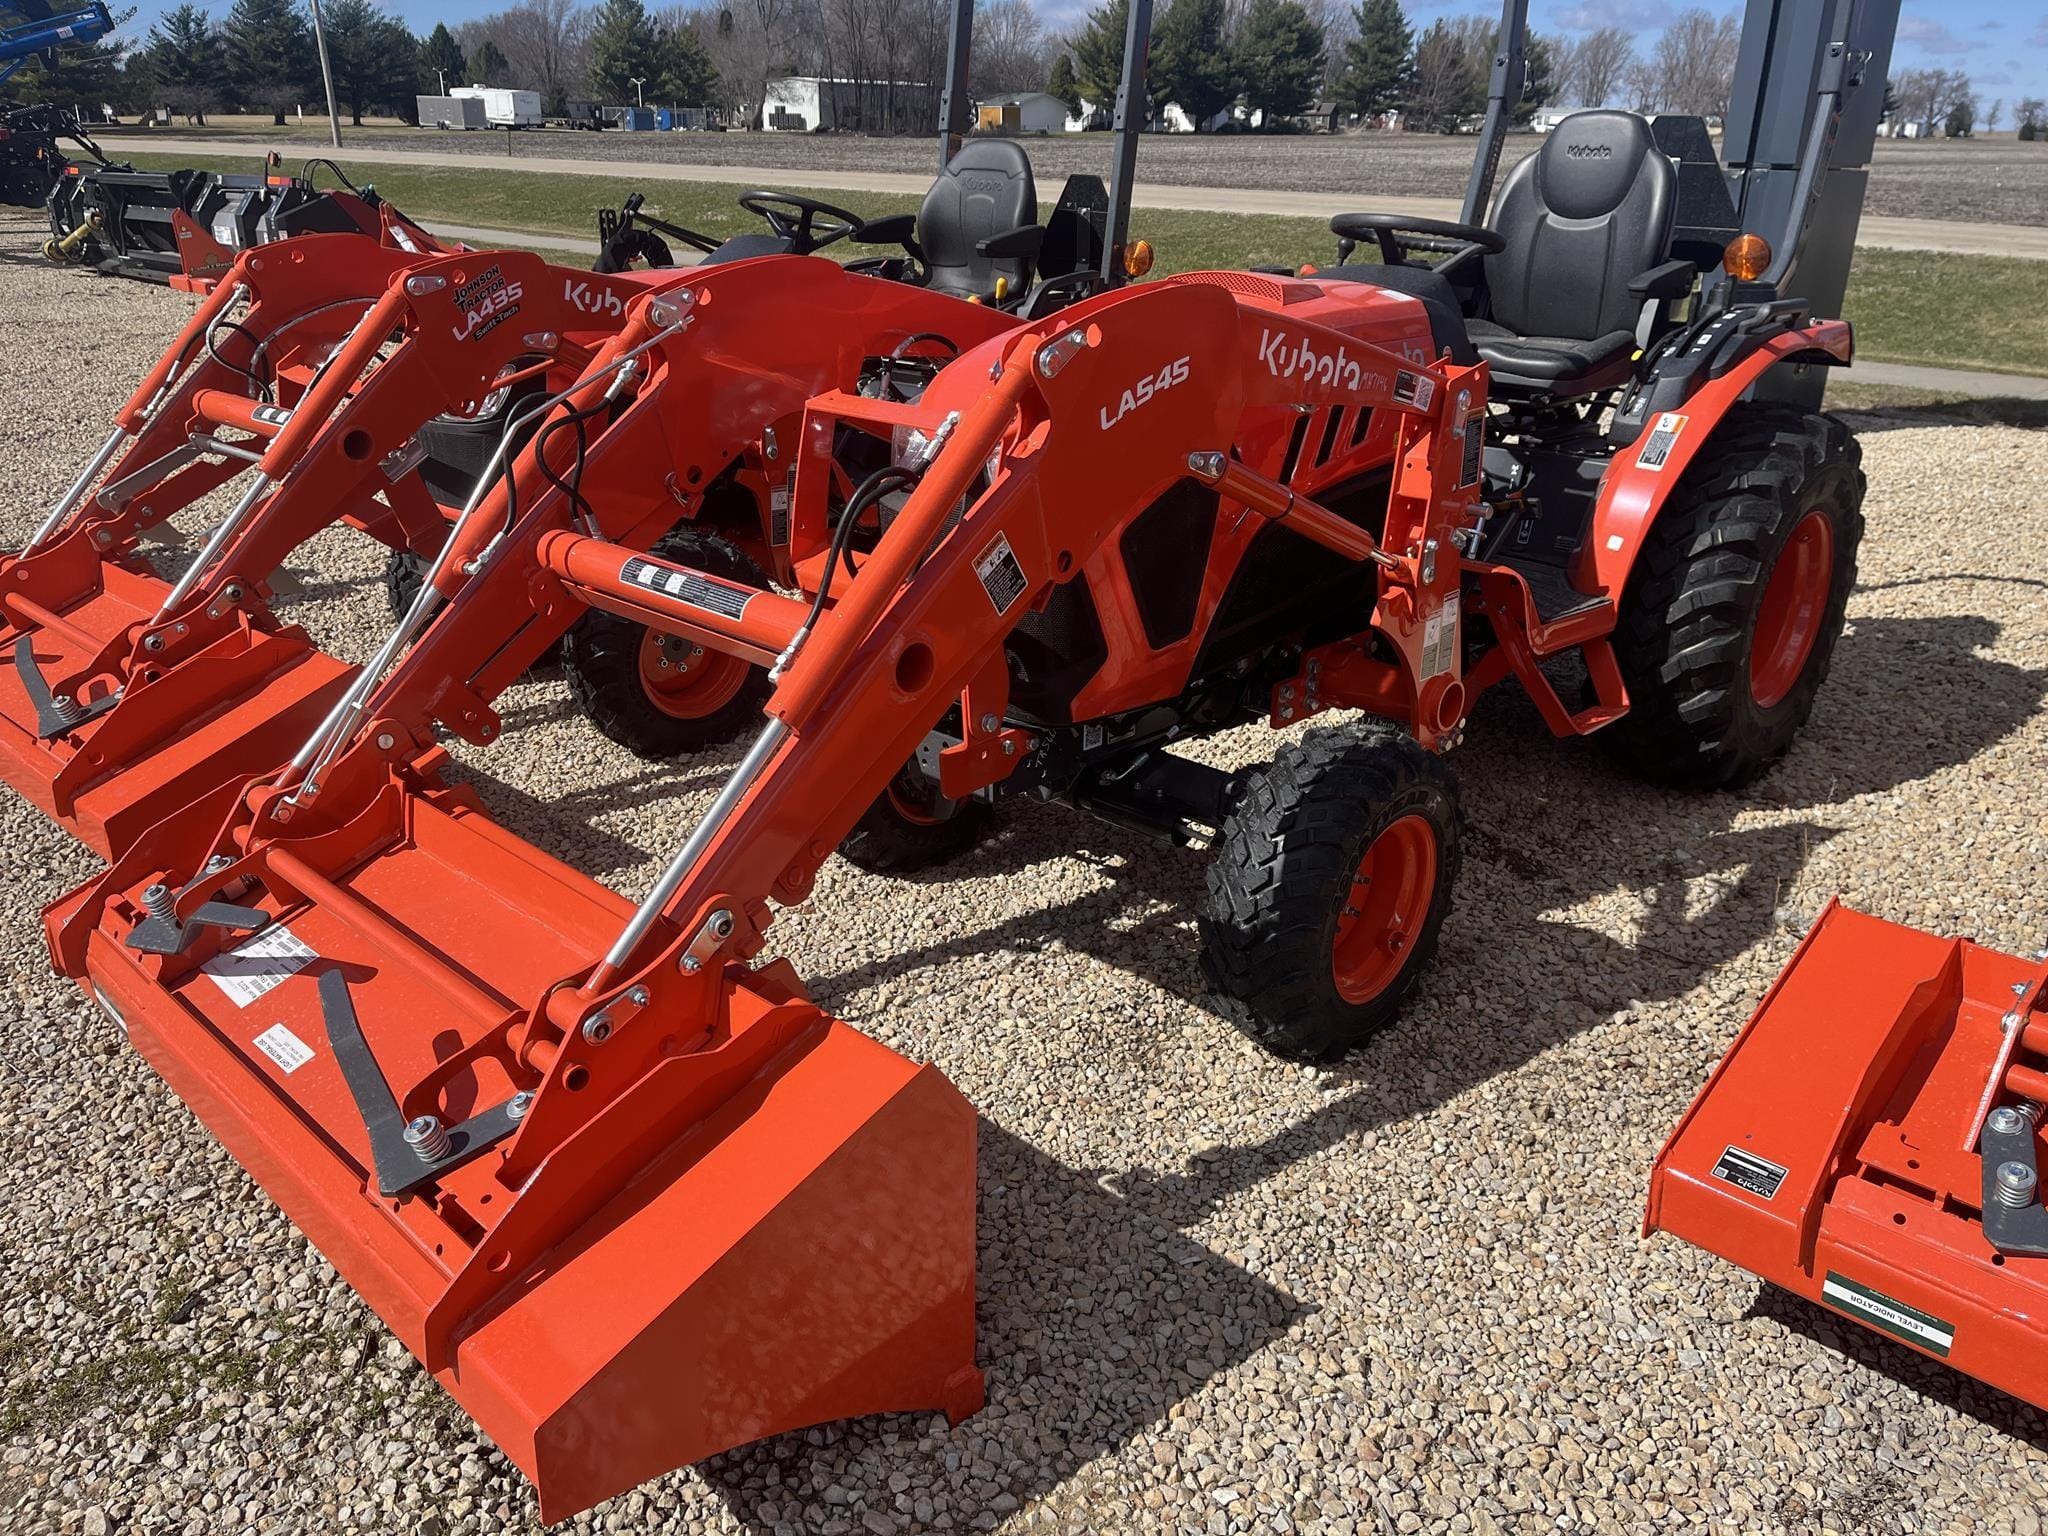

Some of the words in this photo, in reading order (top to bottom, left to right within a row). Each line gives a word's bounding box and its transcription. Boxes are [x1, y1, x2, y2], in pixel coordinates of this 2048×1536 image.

[453, 266, 500, 302] JOHNSON
[457, 278, 505, 314] TRACTOR
[564, 280, 627, 317] Kub
[452, 282, 523, 342] LA435
[475, 306, 518, 340] Swift-Tach
[1259, 328, 1361, 391] Kubota
[1100, 356, 1190, 431] LA545
[1737, 1178, 1771, 1197] Kubota
[1850, 1294, 1895, 1320] INDICATOR
[1898, 1314, 1924, 1332] LEVEL
